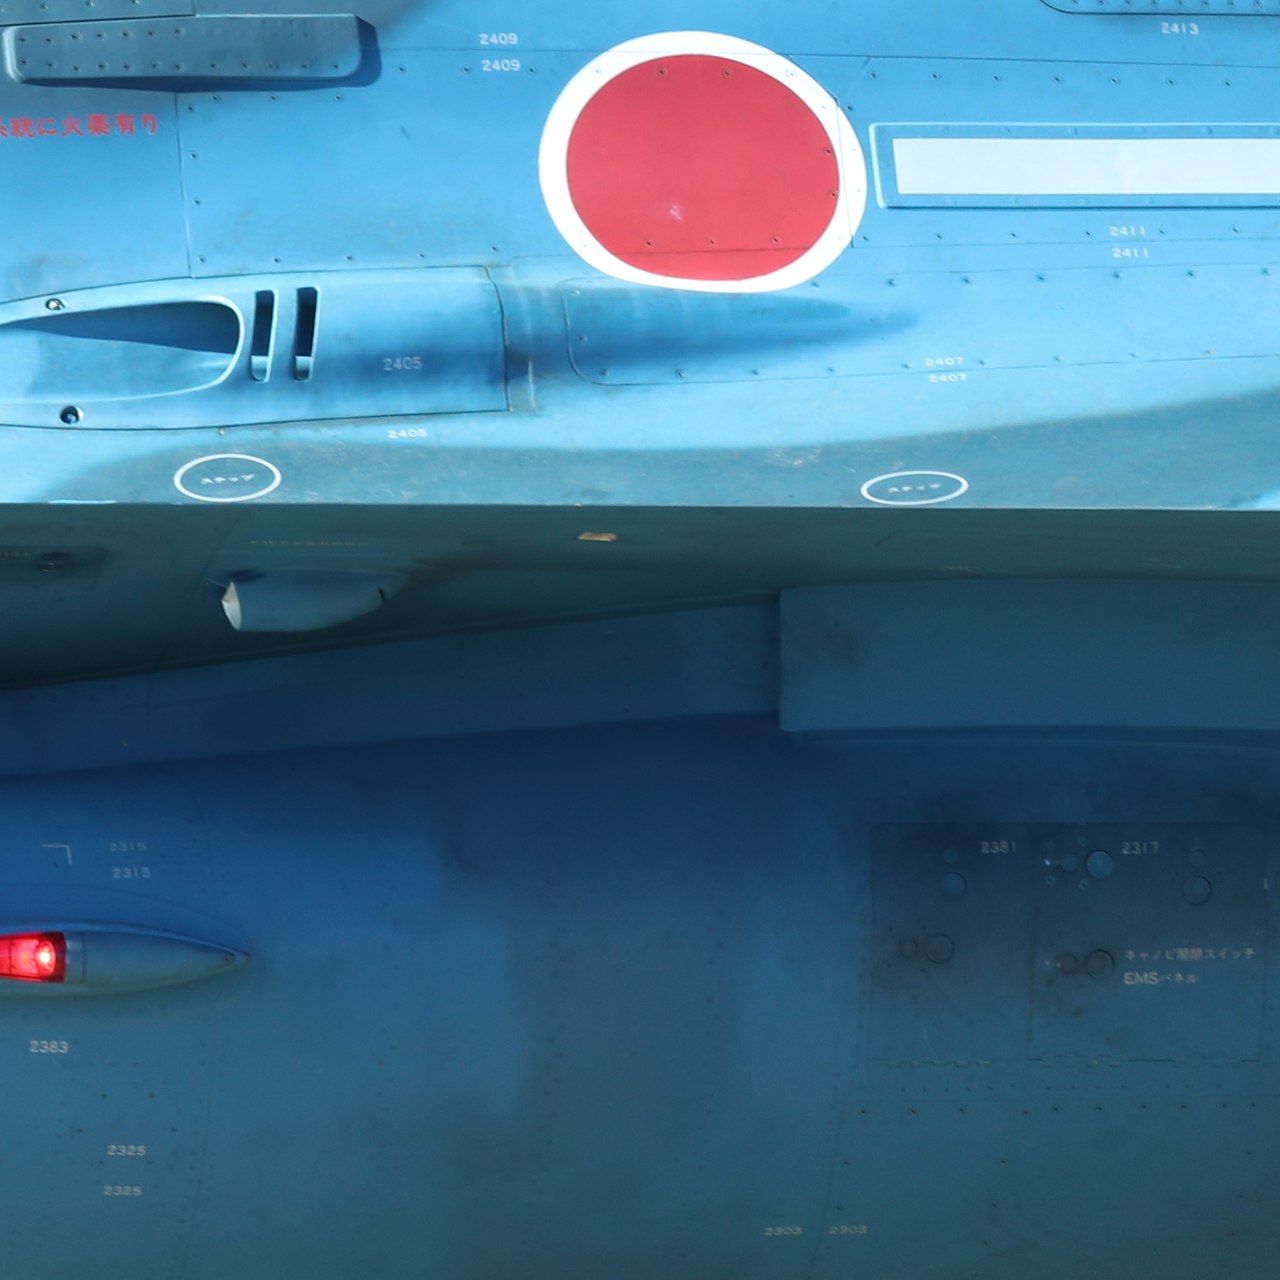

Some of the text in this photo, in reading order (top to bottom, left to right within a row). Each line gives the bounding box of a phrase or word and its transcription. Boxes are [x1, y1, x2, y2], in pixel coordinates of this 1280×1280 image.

[1161, 22, 1200, 35] 2413
[479, 32, 518, 45] 2409
[481, 58, 521, 72] 2409
[1109, 225, 1146, 237] 2411
[1112, 247, 1150, 259] 2411
[383, 356, 422, 371] 2405
[387, 428, 428, 439] 2405
[109, 841, 148, 853] 2315
[1121, 841, 1160, 855] 2317
[112, 866, 152, 879] 2315
[29, 1040, 69, 1054] 2383
[107, 1144, 147, 1156] 2325
[103, 1185, 143, 1197] 2325
